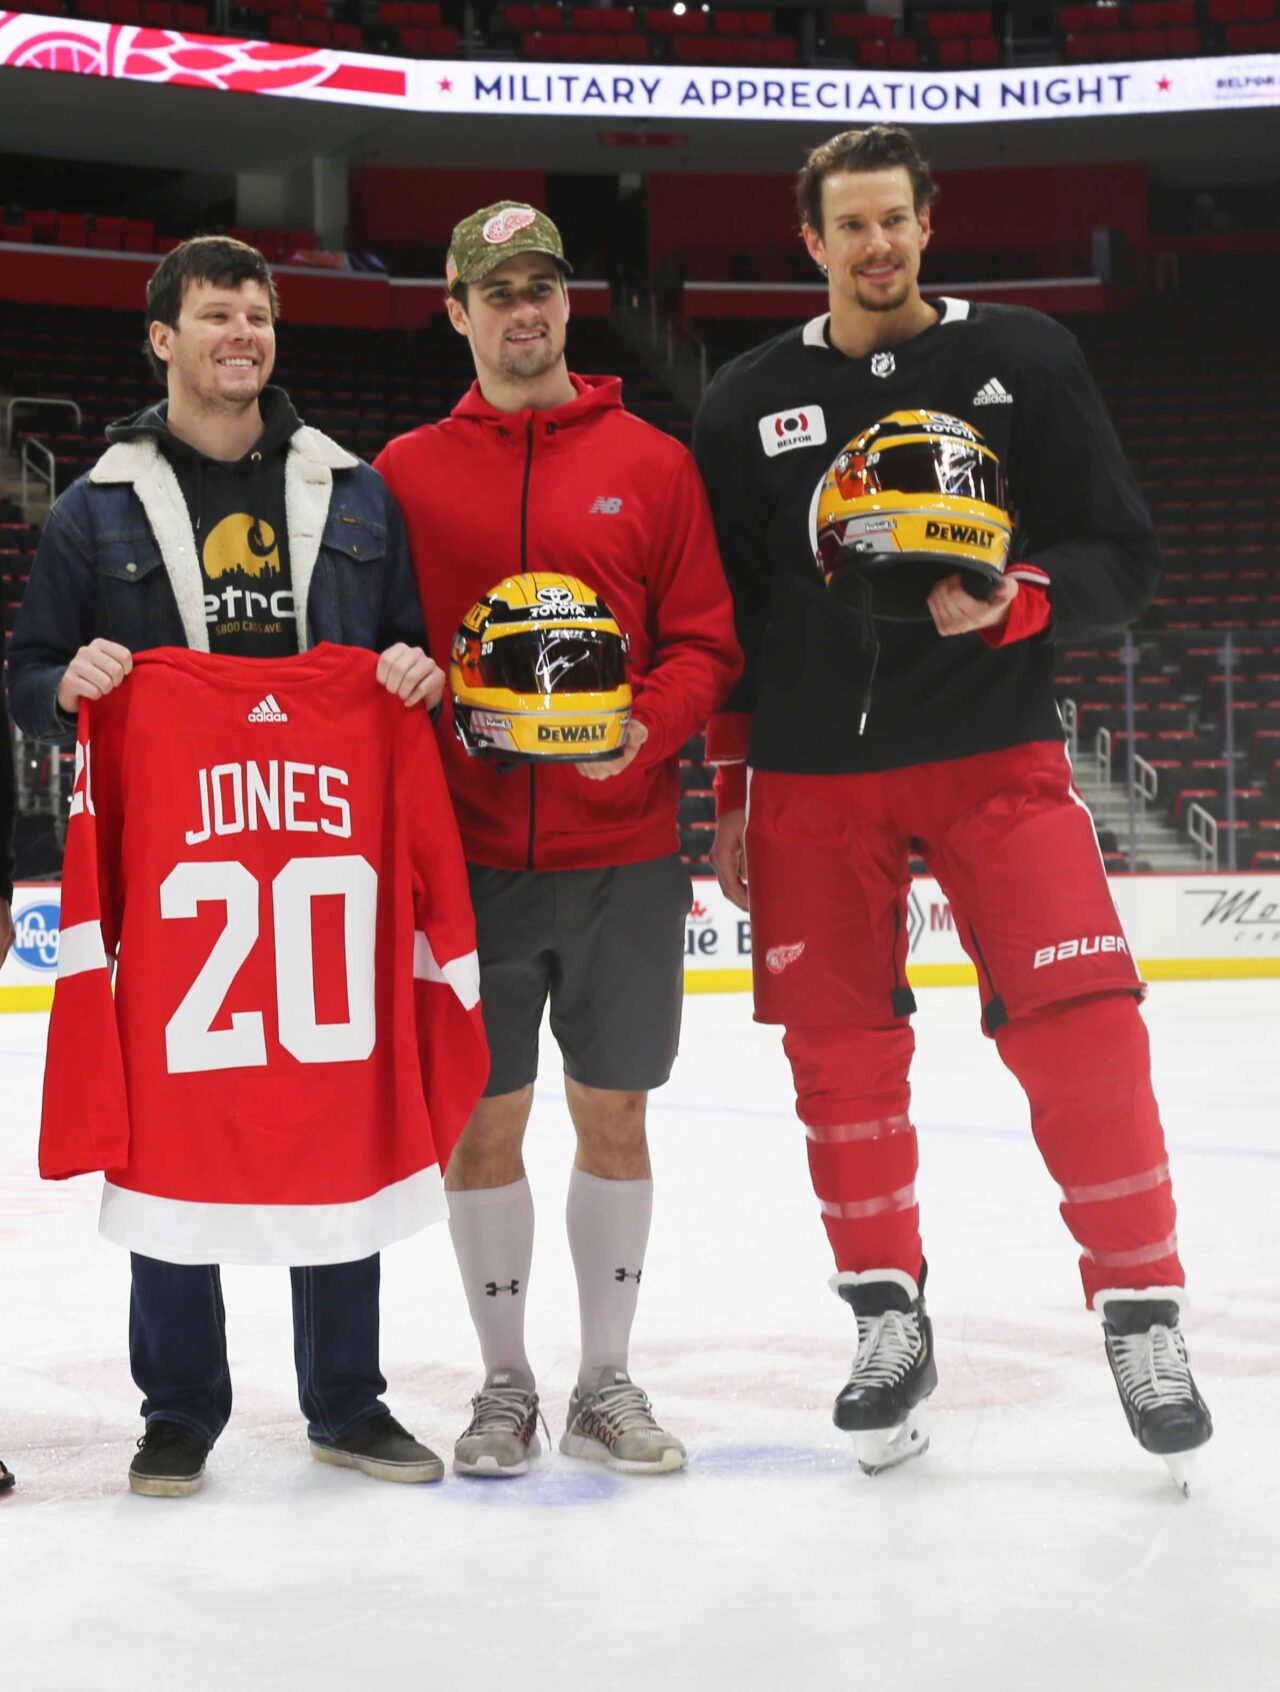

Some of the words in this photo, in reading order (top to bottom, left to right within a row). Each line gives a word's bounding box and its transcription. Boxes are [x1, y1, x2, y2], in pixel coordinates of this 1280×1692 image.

[474, 74, 661, 104] MILITARY
[680, 79, 980, 111] APPRECIATION
[1001, 74, 1132, 107] NIGHT
[973, 393, 1013, 406] adidas
[922, 424, 976, 443] TOYOTA
[776, 435, 812, 449] BELFOR
[530, 605, 586, 617] TOYOTA
[481, 641, 494, 656] 20
[248, 711, 288, 723] adidas
[185, 760, 352, 846] JONES
[159, 854, 378, 1074] 20
